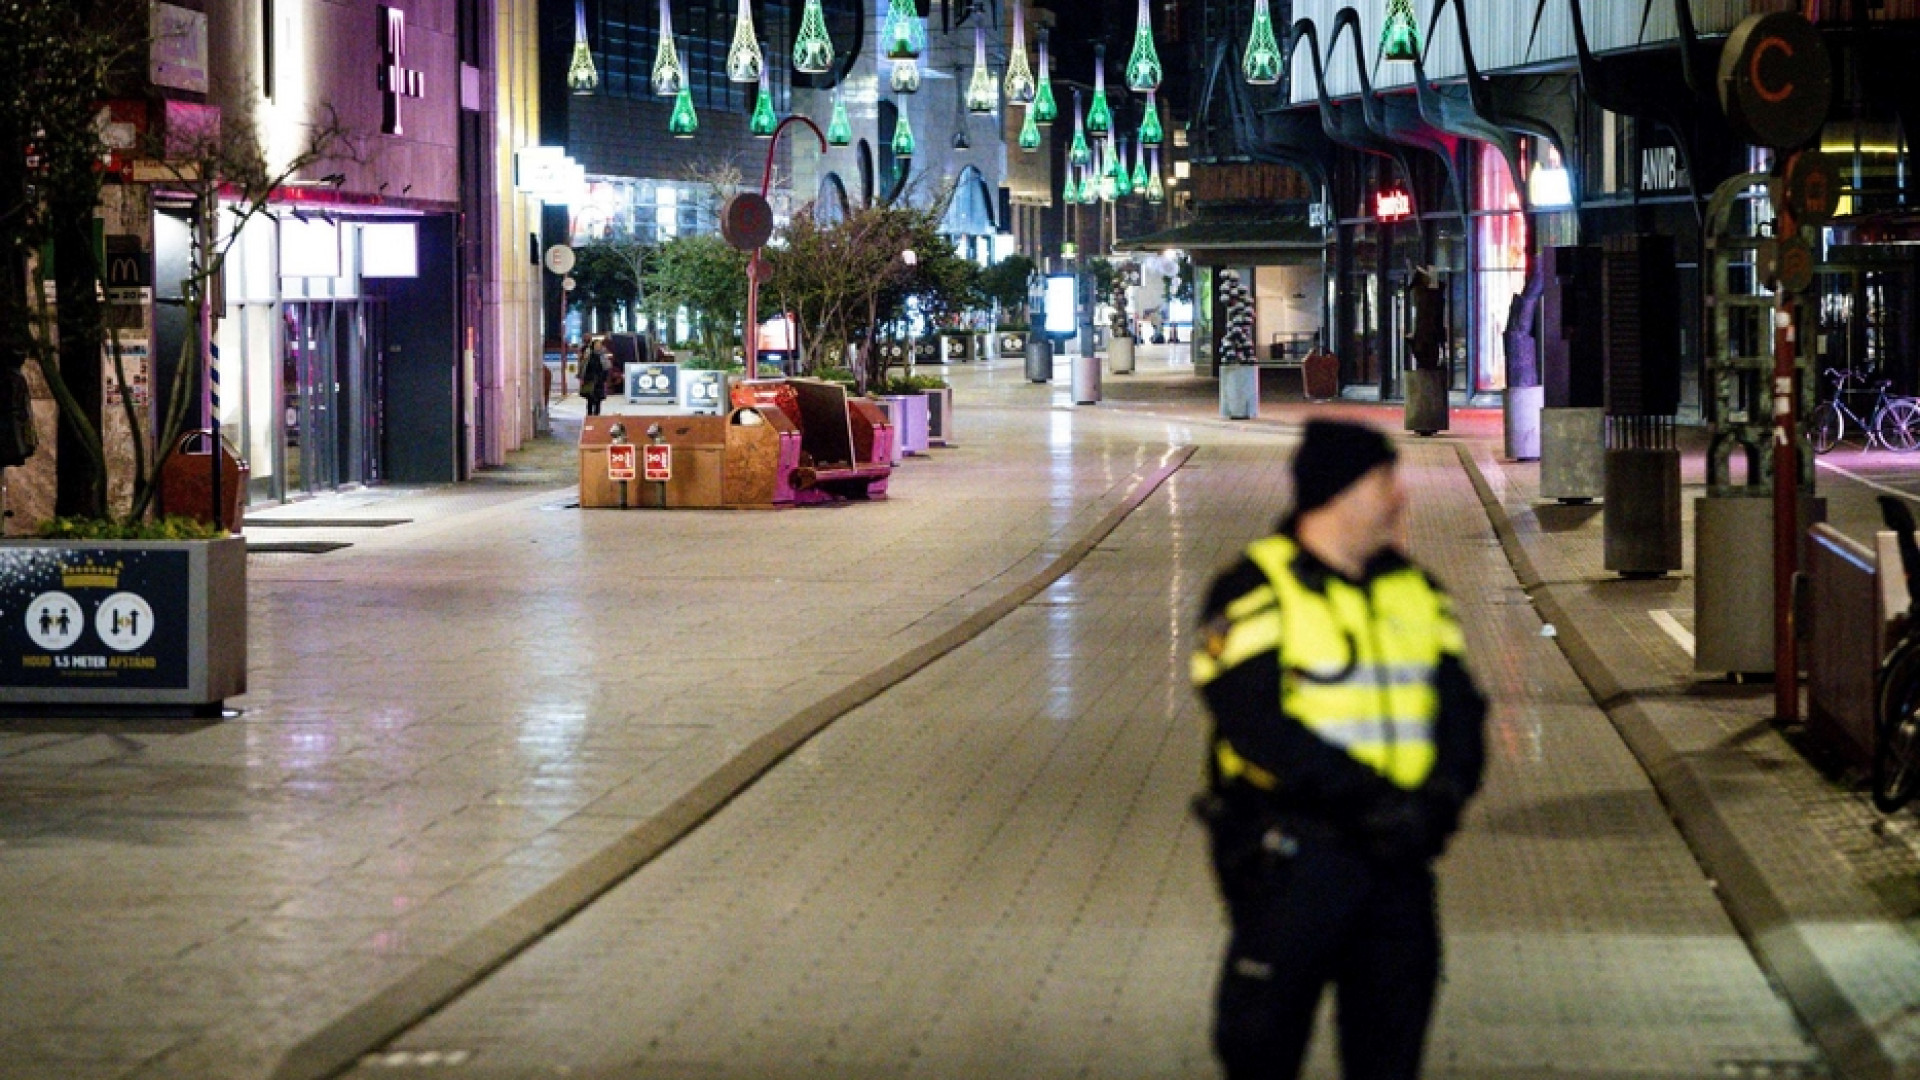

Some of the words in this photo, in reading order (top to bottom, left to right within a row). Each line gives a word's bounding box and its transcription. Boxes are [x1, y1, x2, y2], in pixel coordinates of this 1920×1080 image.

[1751, 36, 1794, 102] C
[1641, 146, 1676, 190] ANWB
[552, 248, 562, 266] E
[71, 655, 108, 669] METER
